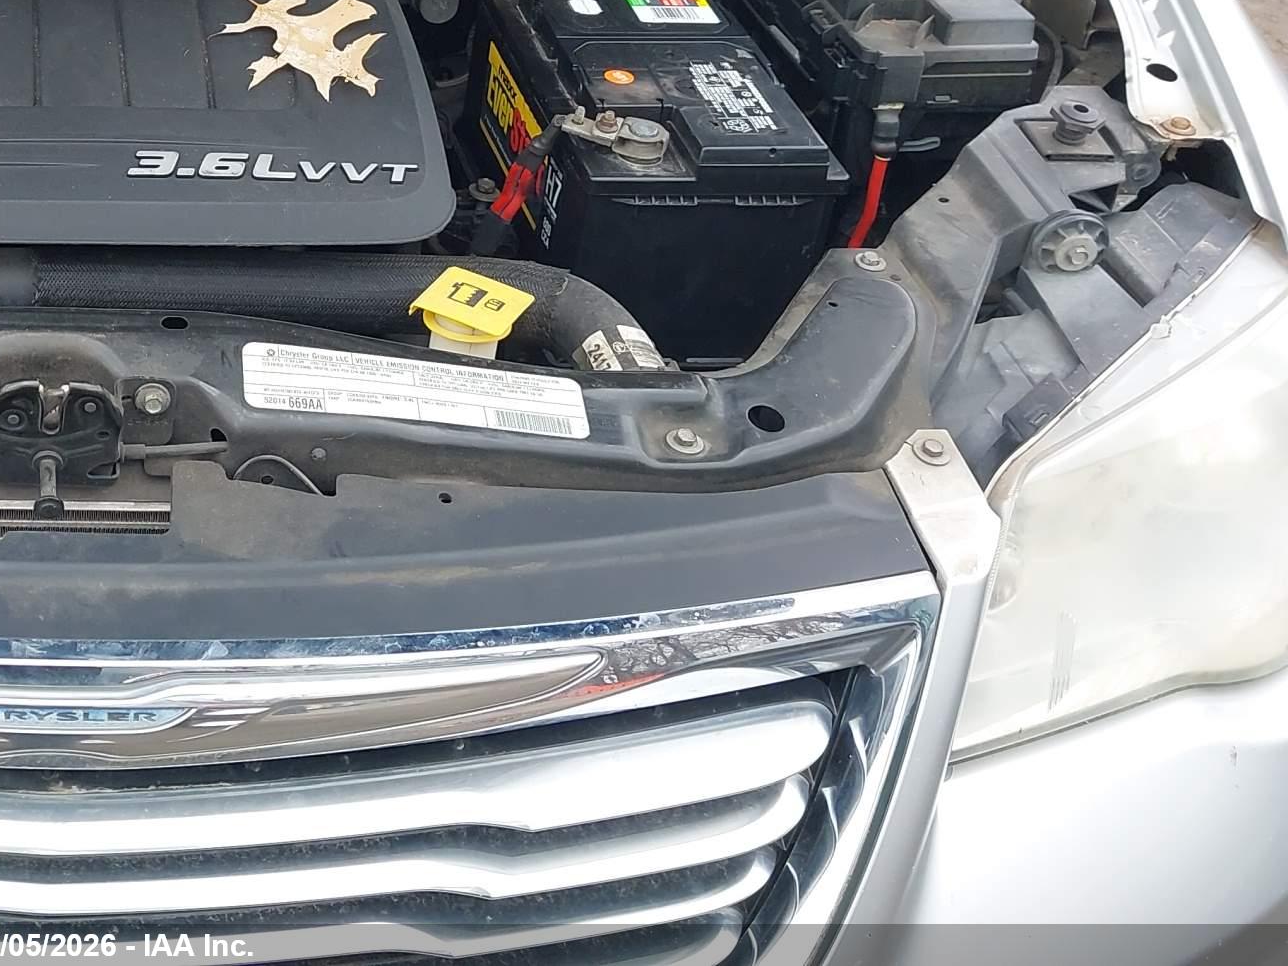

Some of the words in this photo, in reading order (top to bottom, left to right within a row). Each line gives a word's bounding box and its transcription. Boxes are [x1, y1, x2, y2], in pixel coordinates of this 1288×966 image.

[546, 165, 562, 209] H7
[280, 349, 310, 359] Chrysler
[288, 396, 324, 411] 669AA
